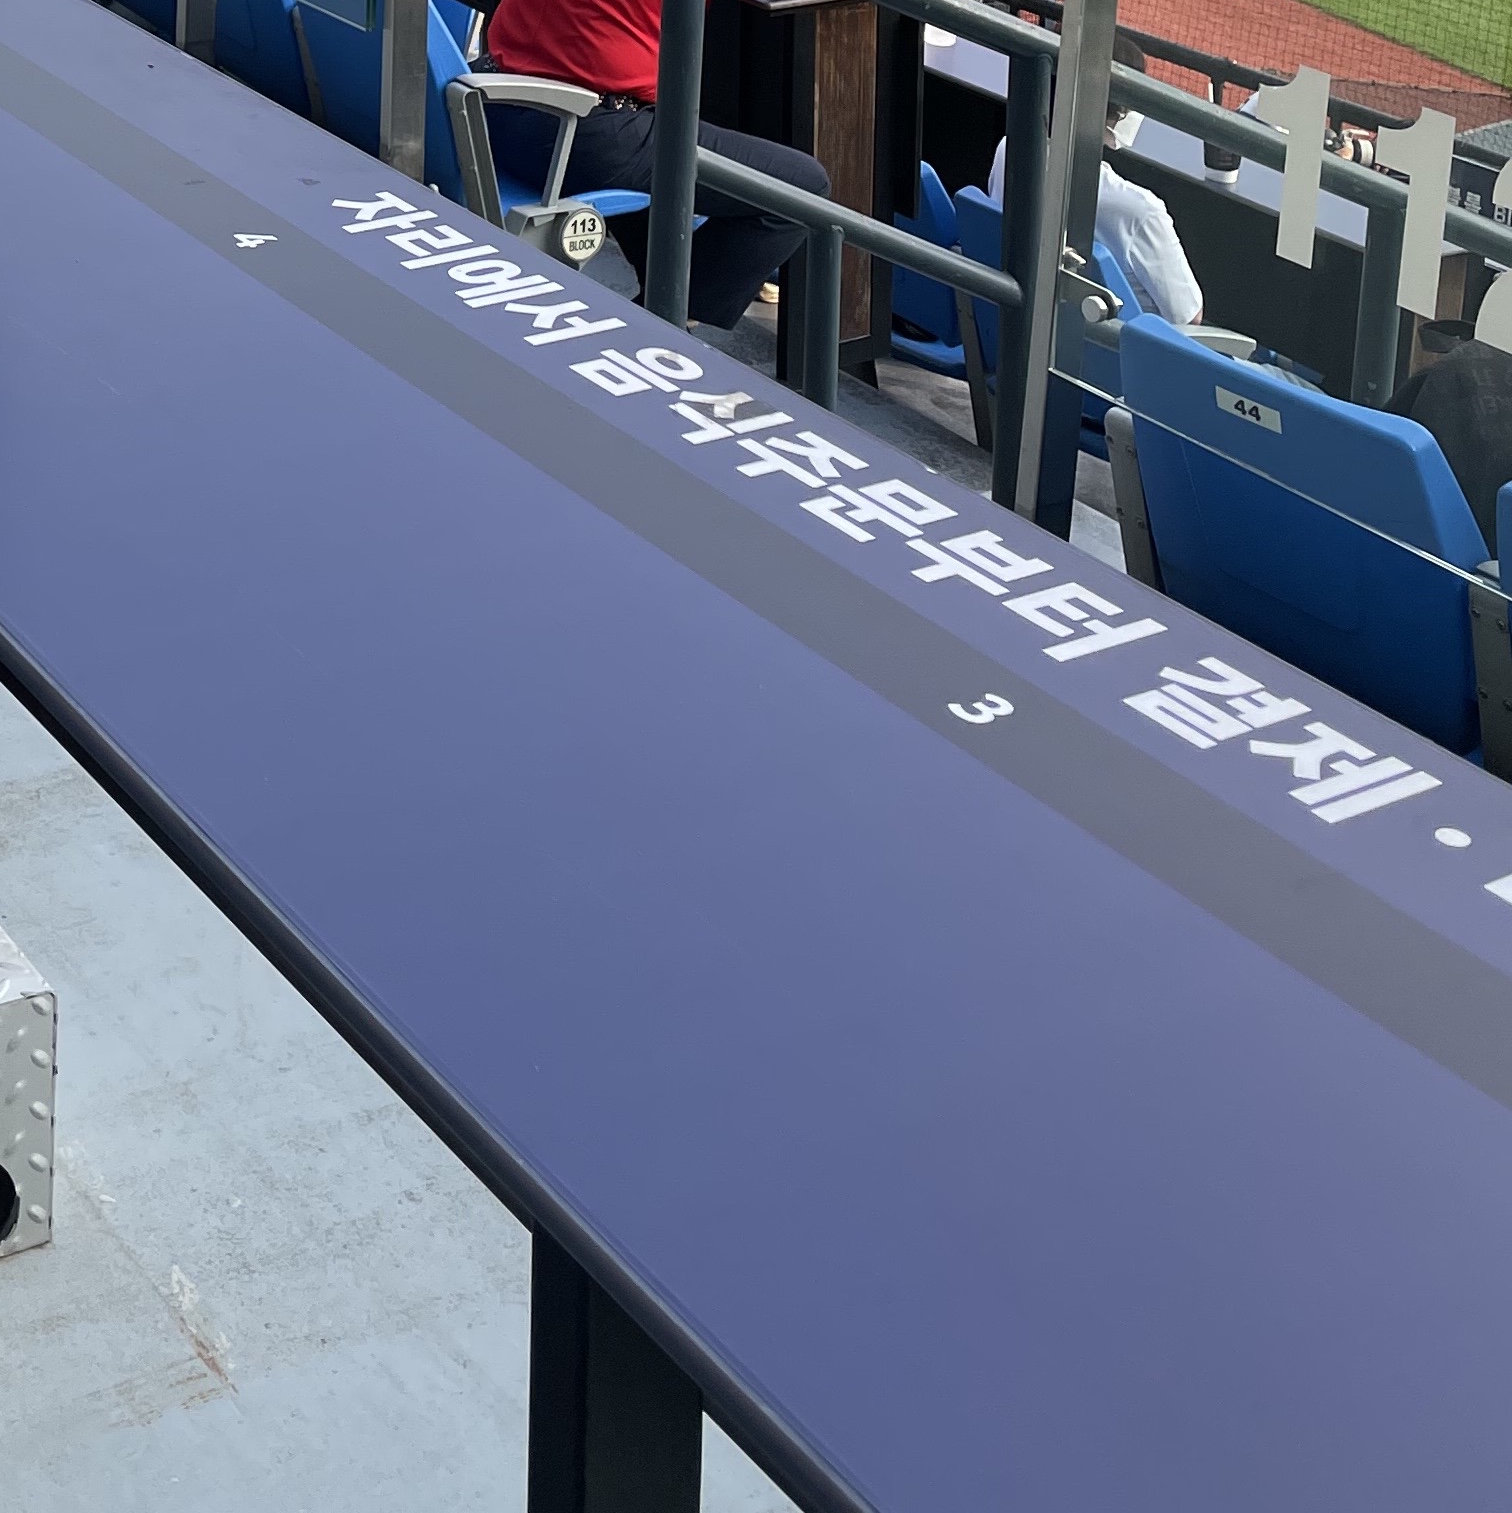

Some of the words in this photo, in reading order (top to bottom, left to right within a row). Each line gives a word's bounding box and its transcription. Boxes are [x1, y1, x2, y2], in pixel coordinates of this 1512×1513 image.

[571, 217, 596, 234] 113
[232, 230, 278, 249] 4
[569, 238, 596, 252] BLOCK
[1233, 399, 1262, 422] 44
[331, 190, 628, 347] 자리에서
[569, 347, 1169, 662] 음식주문부터
[1122, 656, 1443, 824] 결제
[947, 692, 1015, 725] 3
